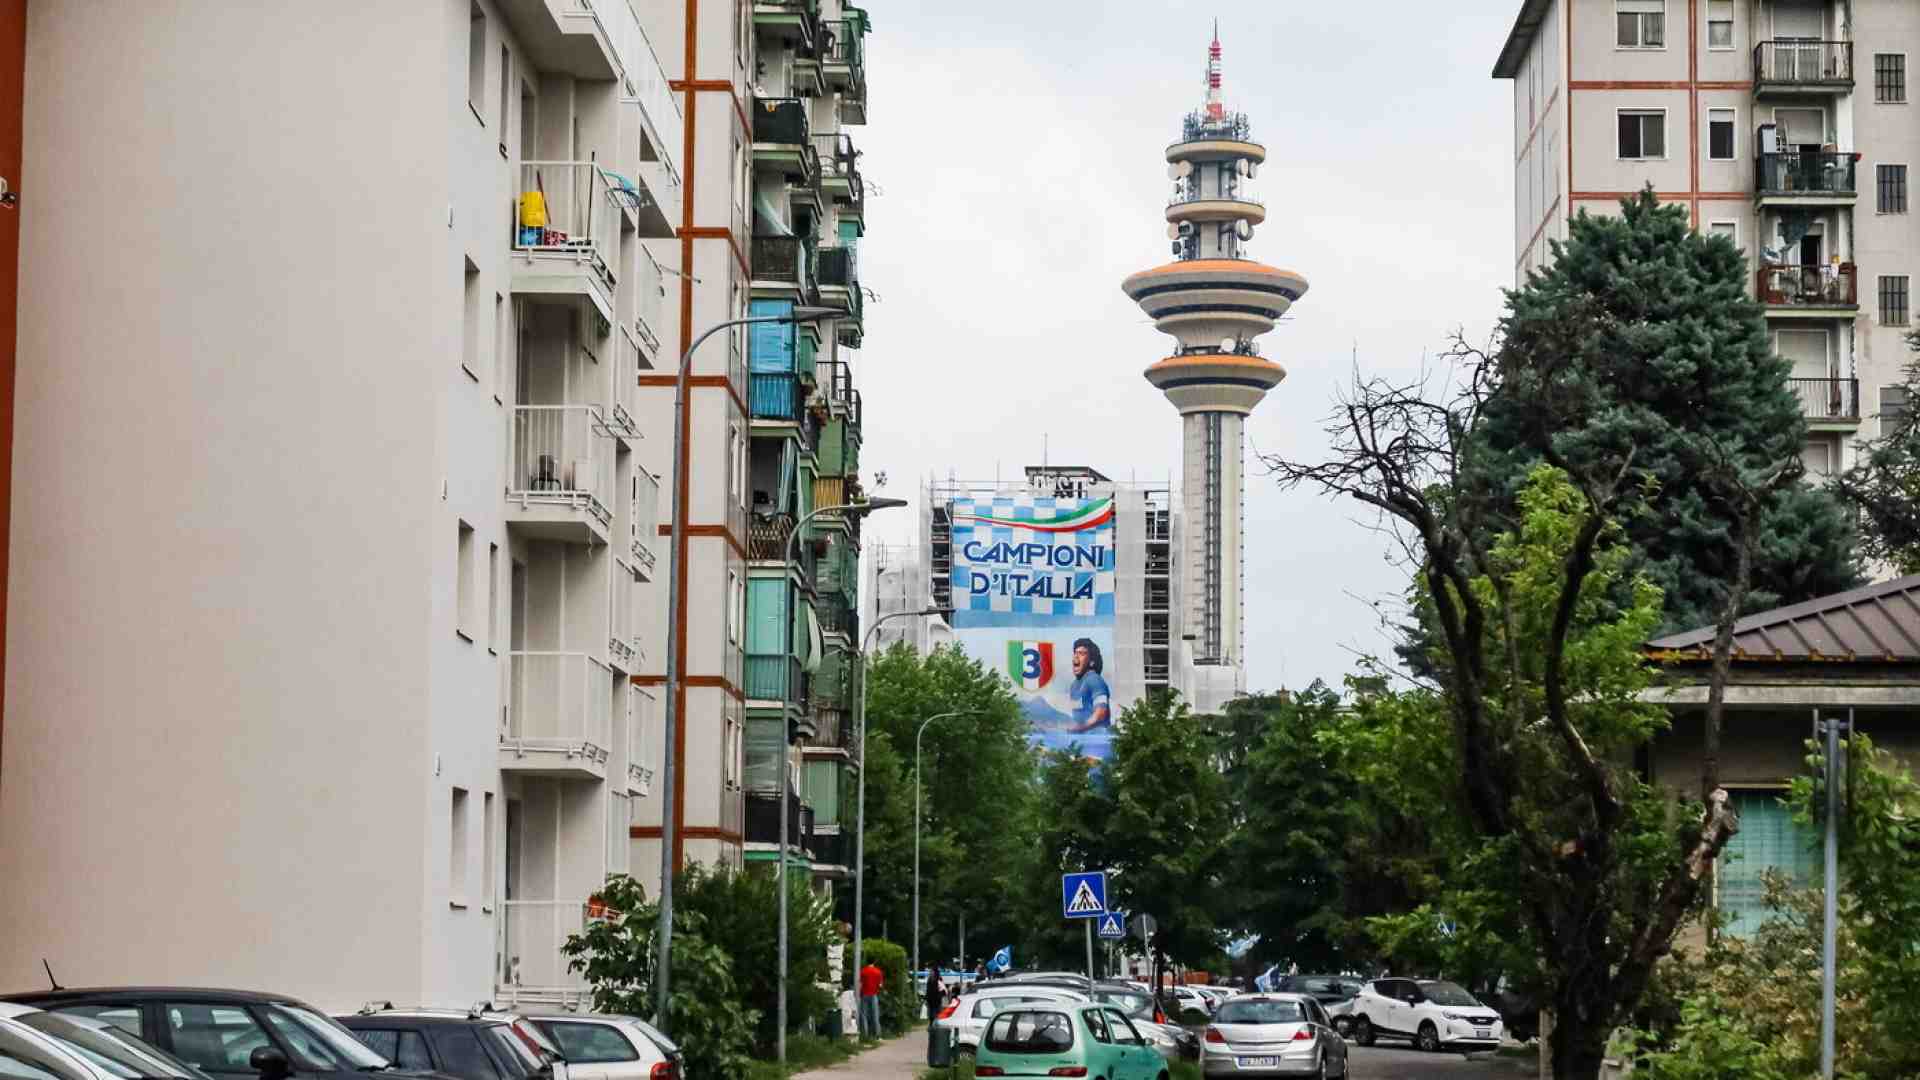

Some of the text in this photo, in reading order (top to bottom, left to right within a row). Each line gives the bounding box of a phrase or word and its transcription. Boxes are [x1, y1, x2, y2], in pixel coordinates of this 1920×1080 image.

[964, 541, 1105, 567] CAMPIONI
[970, 572, 1094, 599] D'ITALIA
[1022, 649, 1041, 679] 3
